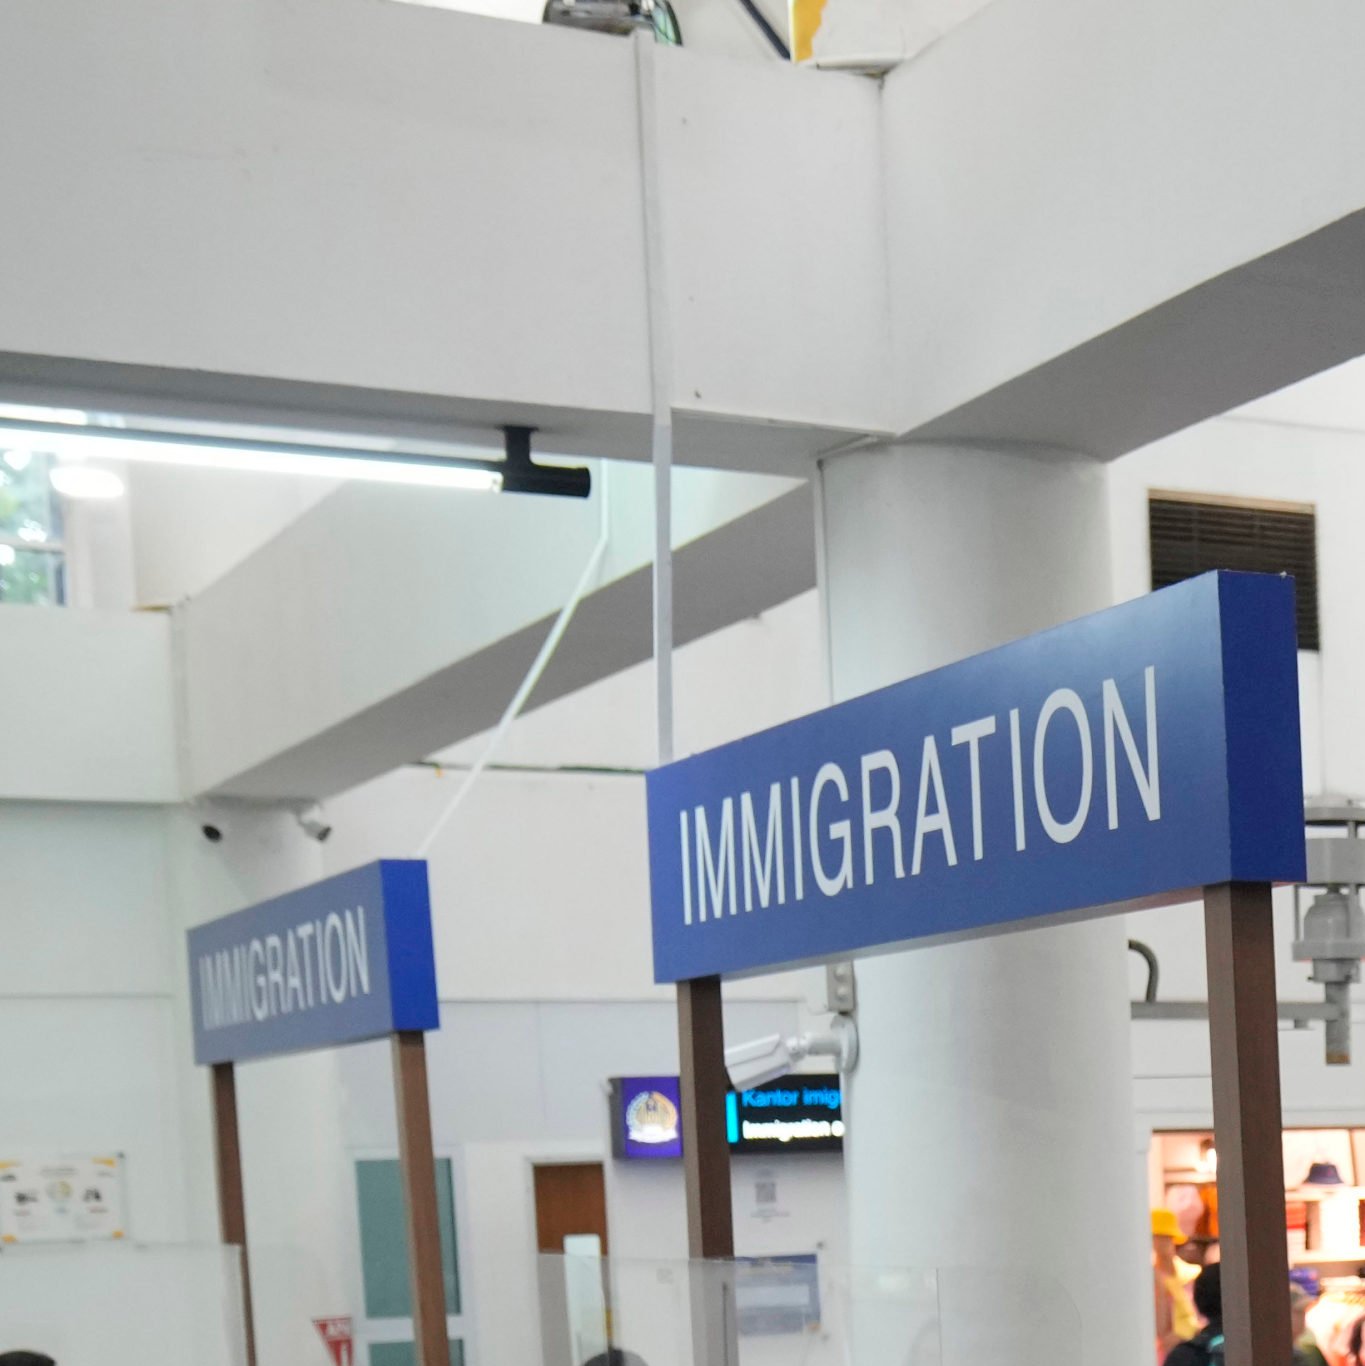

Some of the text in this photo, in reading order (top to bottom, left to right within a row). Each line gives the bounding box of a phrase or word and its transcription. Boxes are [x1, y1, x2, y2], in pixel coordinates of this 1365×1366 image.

[679, 664, 1161, 926] IMMIGRATION
[200, 905, 370, 1031] IMMIGRATION
[742, 1088, 799, 1107] Kantor
